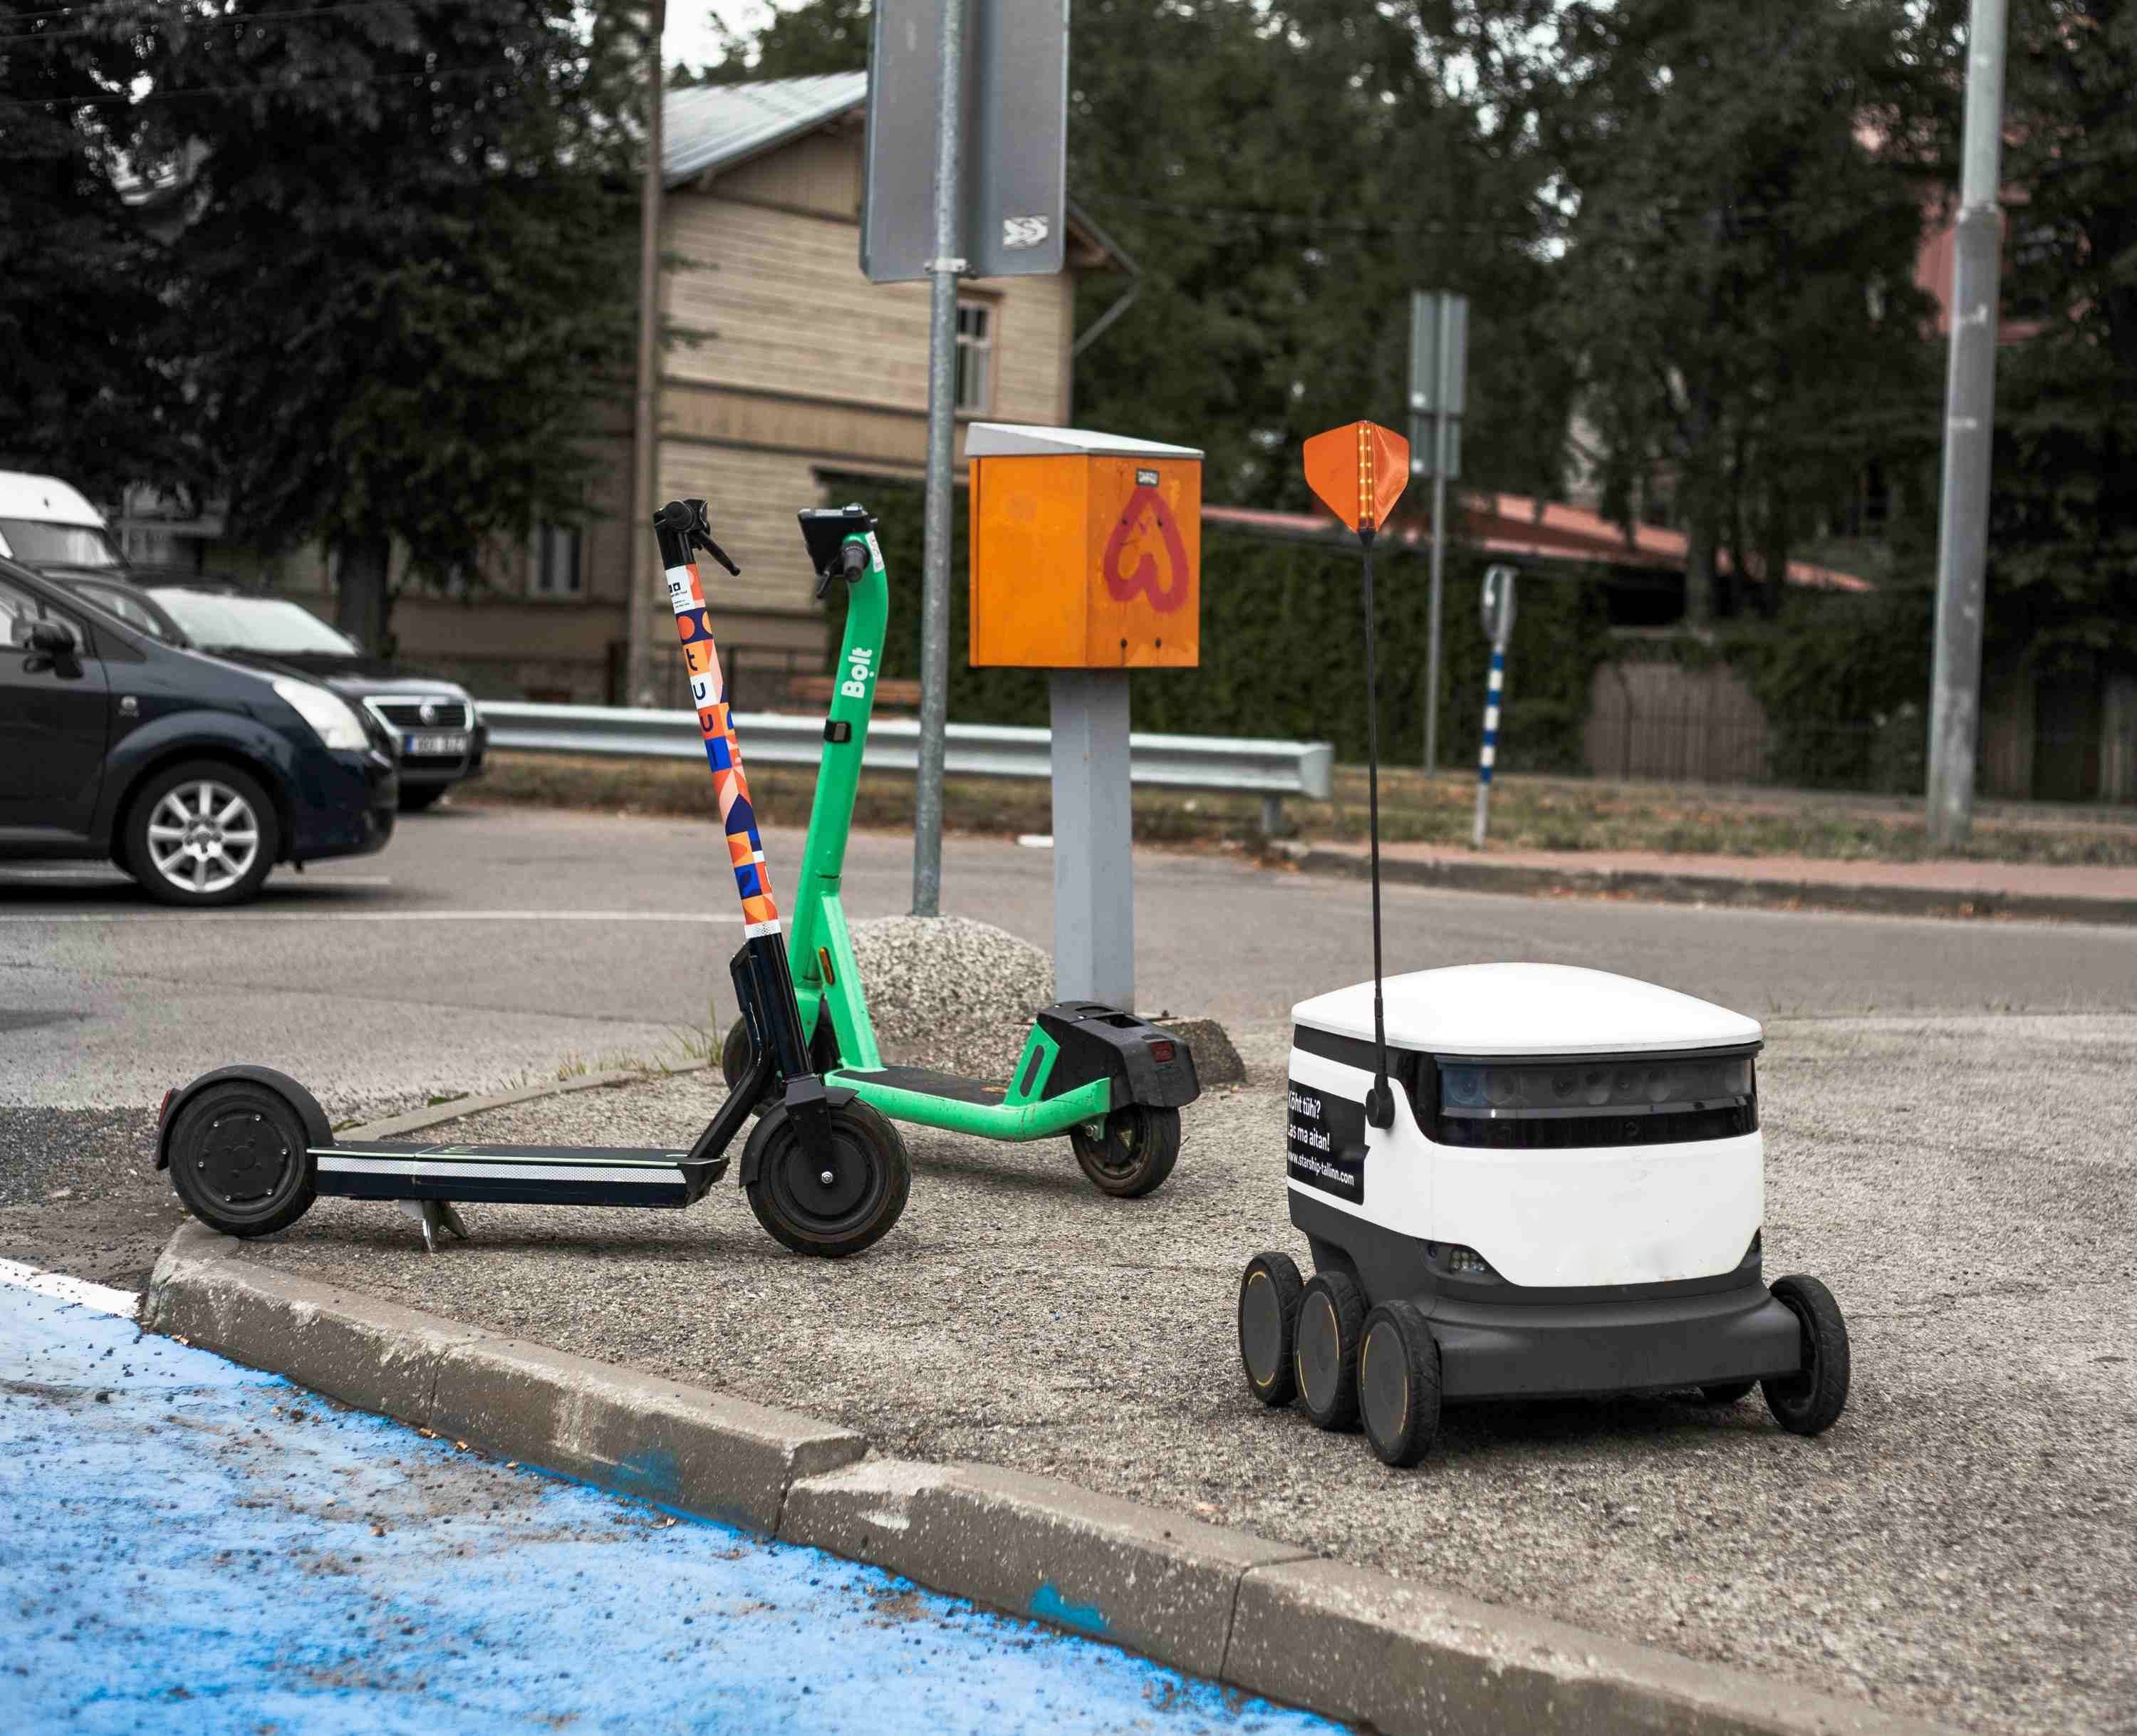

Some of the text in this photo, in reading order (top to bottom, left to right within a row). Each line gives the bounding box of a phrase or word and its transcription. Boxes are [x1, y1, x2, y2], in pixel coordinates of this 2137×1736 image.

[841, 647, 875, 698] Bolt
[1303, 1096, 1321, 1119] tühi?
[1297, 1126, 1308, 1143] ma
[1309, 1128, 1330, 1151] aitan!
